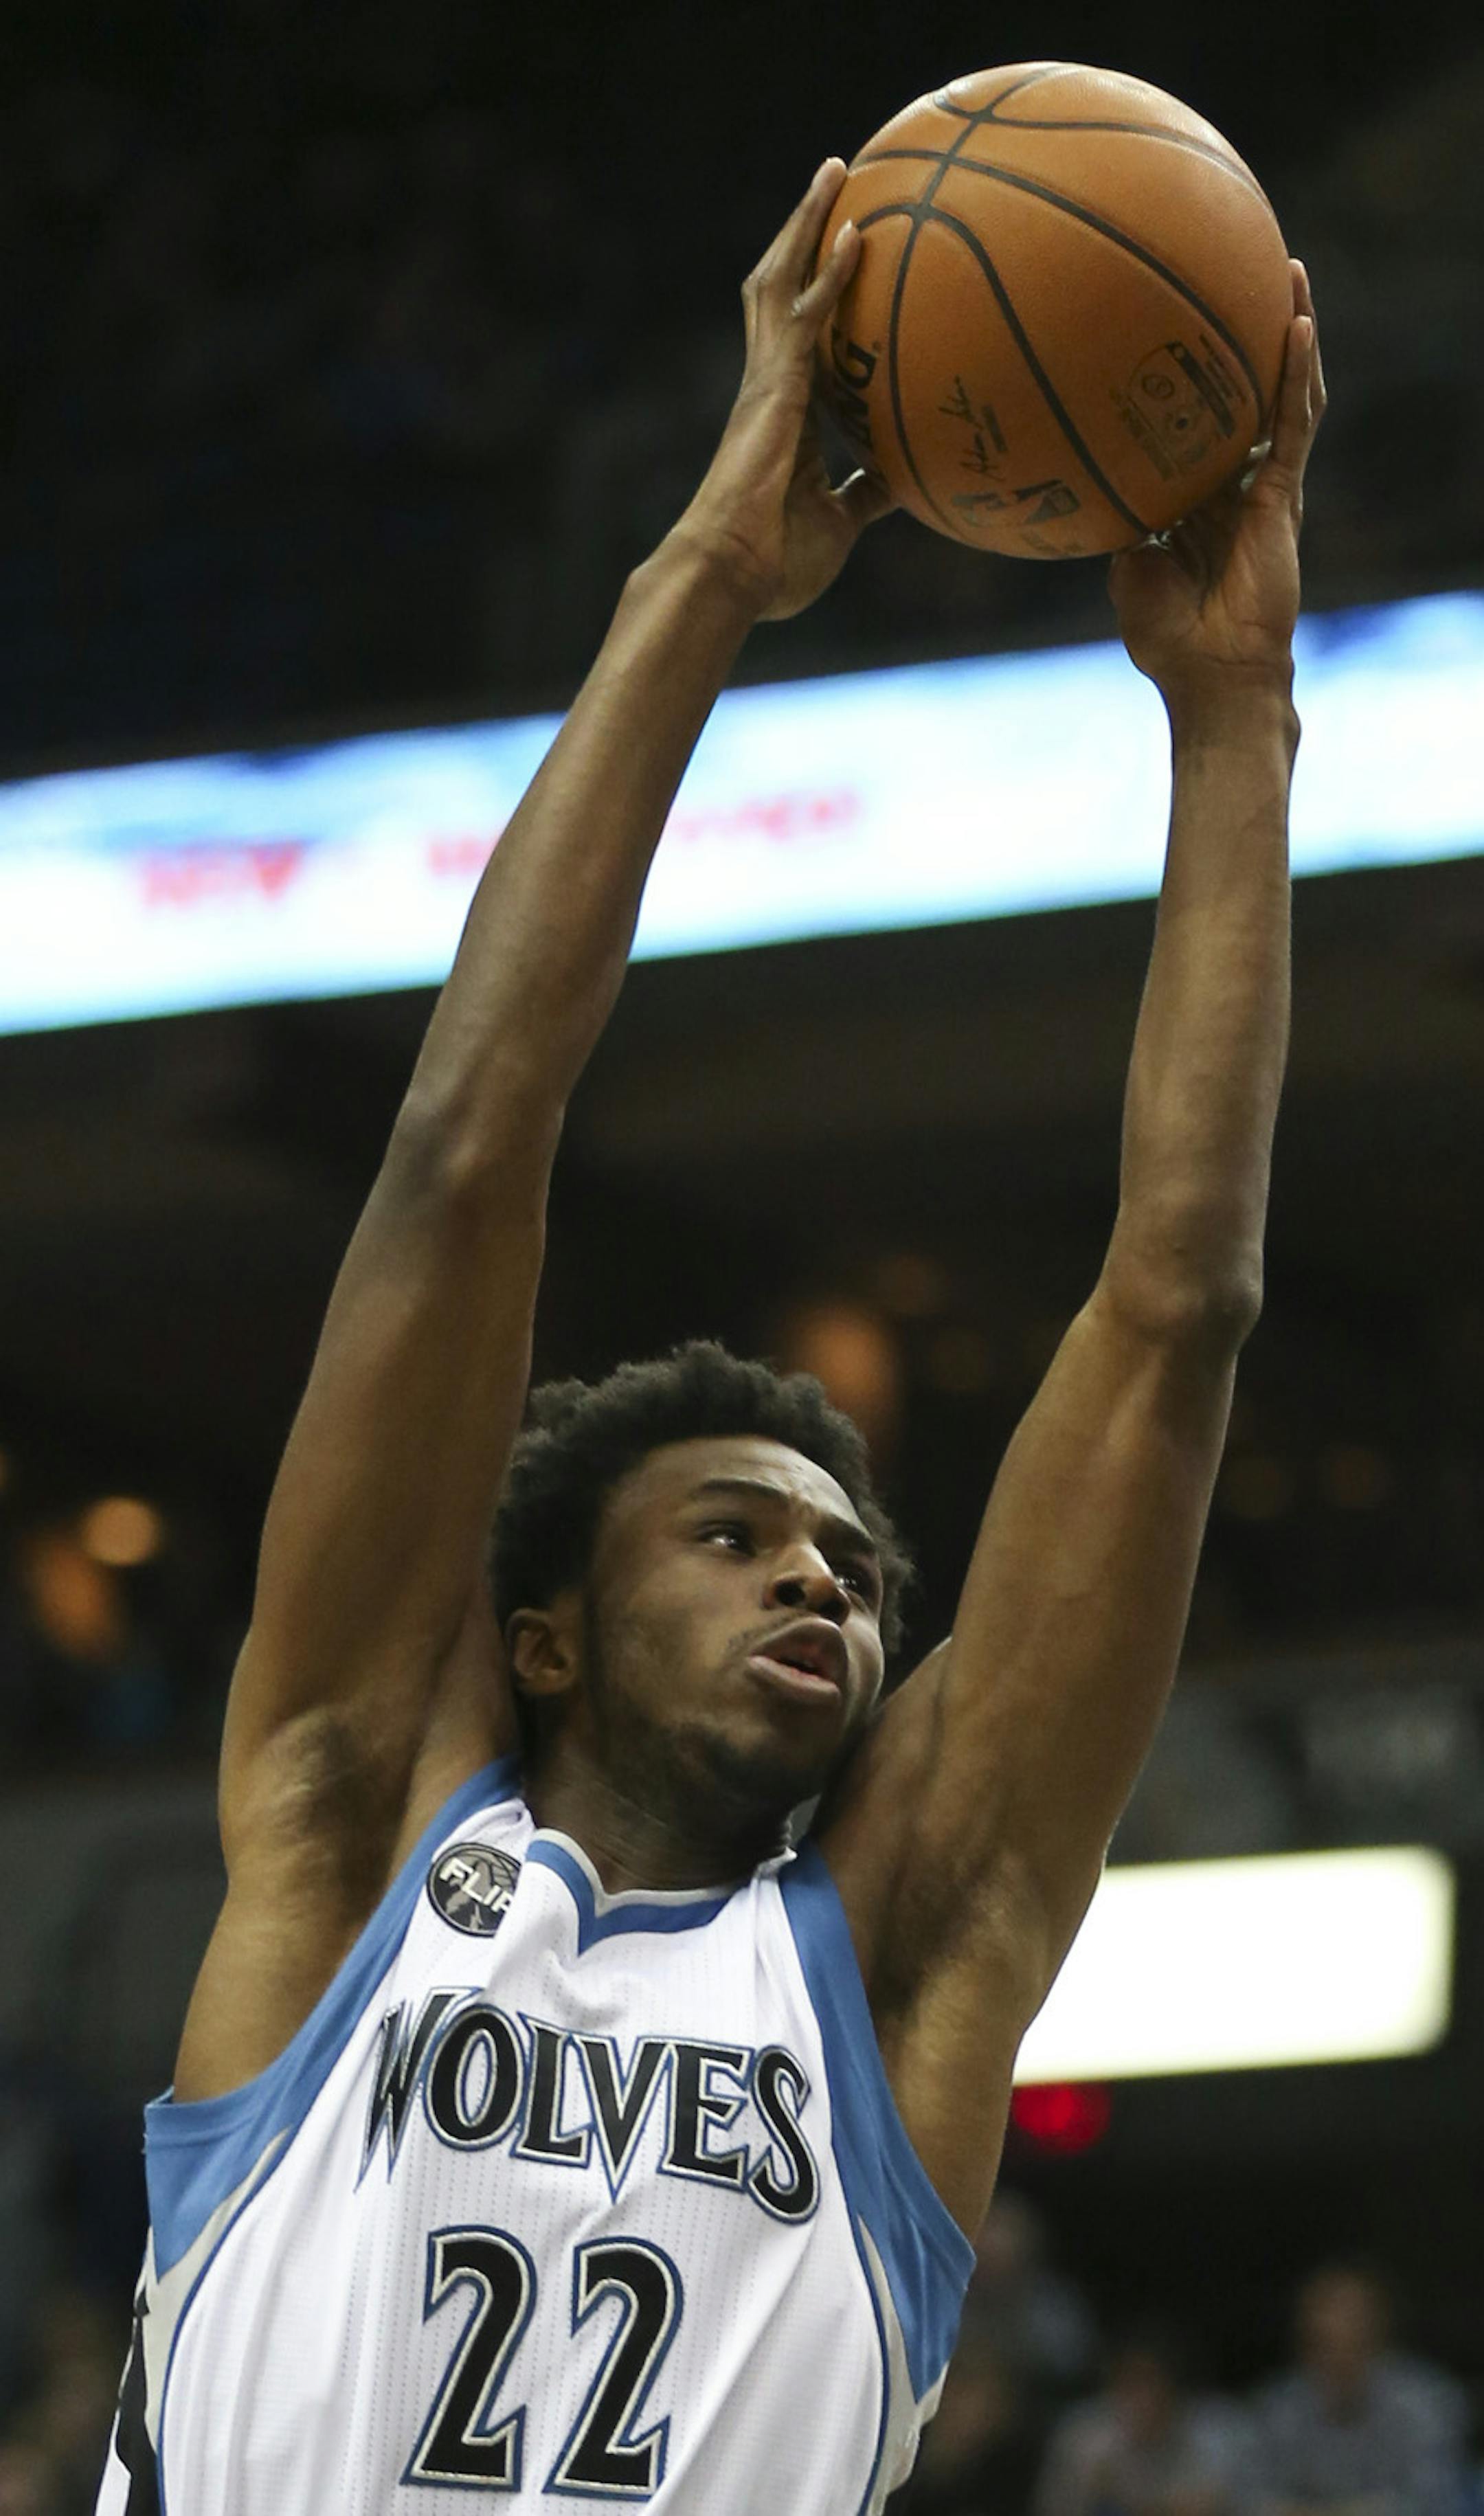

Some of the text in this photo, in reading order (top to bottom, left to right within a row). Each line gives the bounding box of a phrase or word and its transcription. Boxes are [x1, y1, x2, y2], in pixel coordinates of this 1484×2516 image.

[440, 1856, 514, 1913] FLIP
[355, 1986, 820, 2225] WOLVES
[401, 2226, 684, 2501] 22
